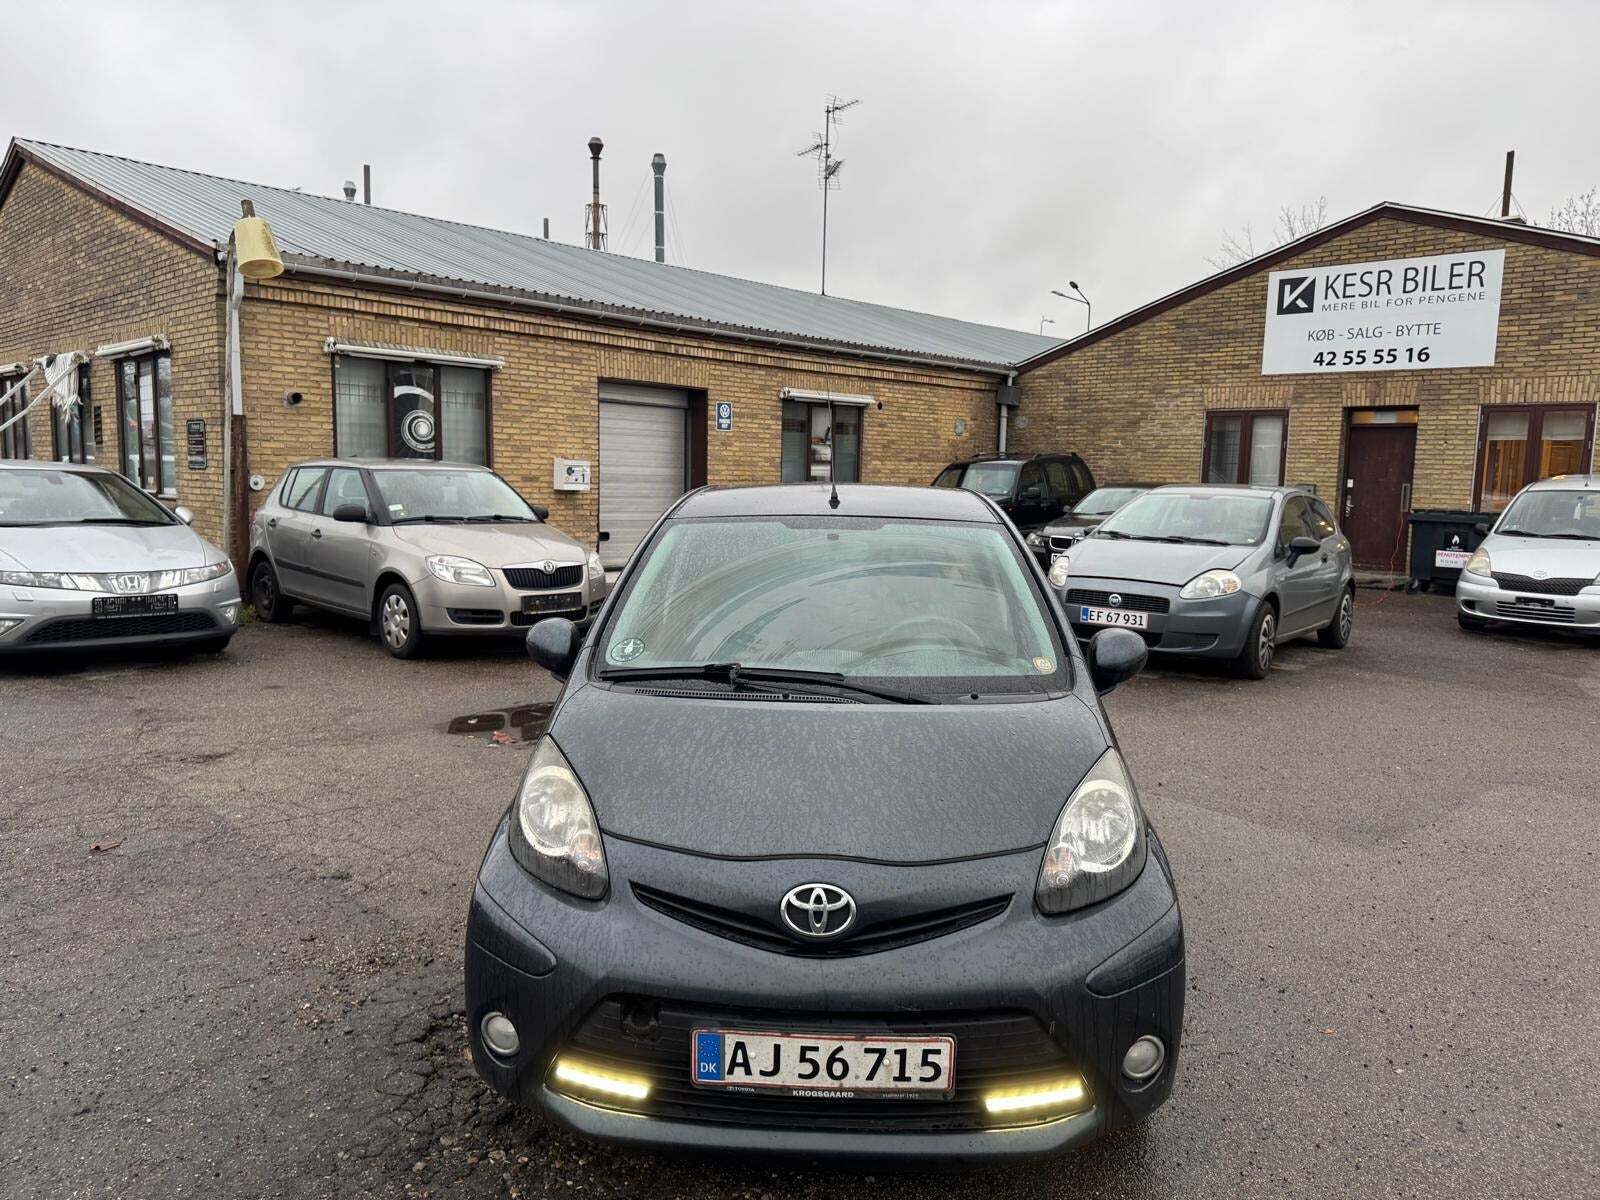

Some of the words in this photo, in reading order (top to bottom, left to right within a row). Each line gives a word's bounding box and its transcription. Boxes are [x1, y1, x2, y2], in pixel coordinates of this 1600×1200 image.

[1324, 269, 1392, 300] KESR
[1402, 260, 1486, 294] BILER
[1321, 301, 1355, 312] MERE
[1361, 300, 1380, 309] BIL
[1387, 297, 1413, 307] FOR
[1419, 291, 1486, 305] PENGENE
[1308, 328, 1335, 342] KØB
[1347, 326, 1383, 340] SALG
[1396, 322, 1441, 337] BYTTE
[1313, 351, 1337, 366] 42
[1343, 349, 1366, 365] 55
[1373, 348, 1397, 364] 55
[1405, 346, 1430, 363] 16
[1089, 610, 1103, 621] EF
[1106, 612, 1120, 623] 67
[1123, 614, 1144, 626] 931
[700, 1062, 717, 1073] DK
[726, 1041, 781, 1077] AJ
[797, 1046, 850, 1081] 56
[863, 1047, 942, 1083] 715
[792, 1090, 854, 1098] KROGSGAARD
